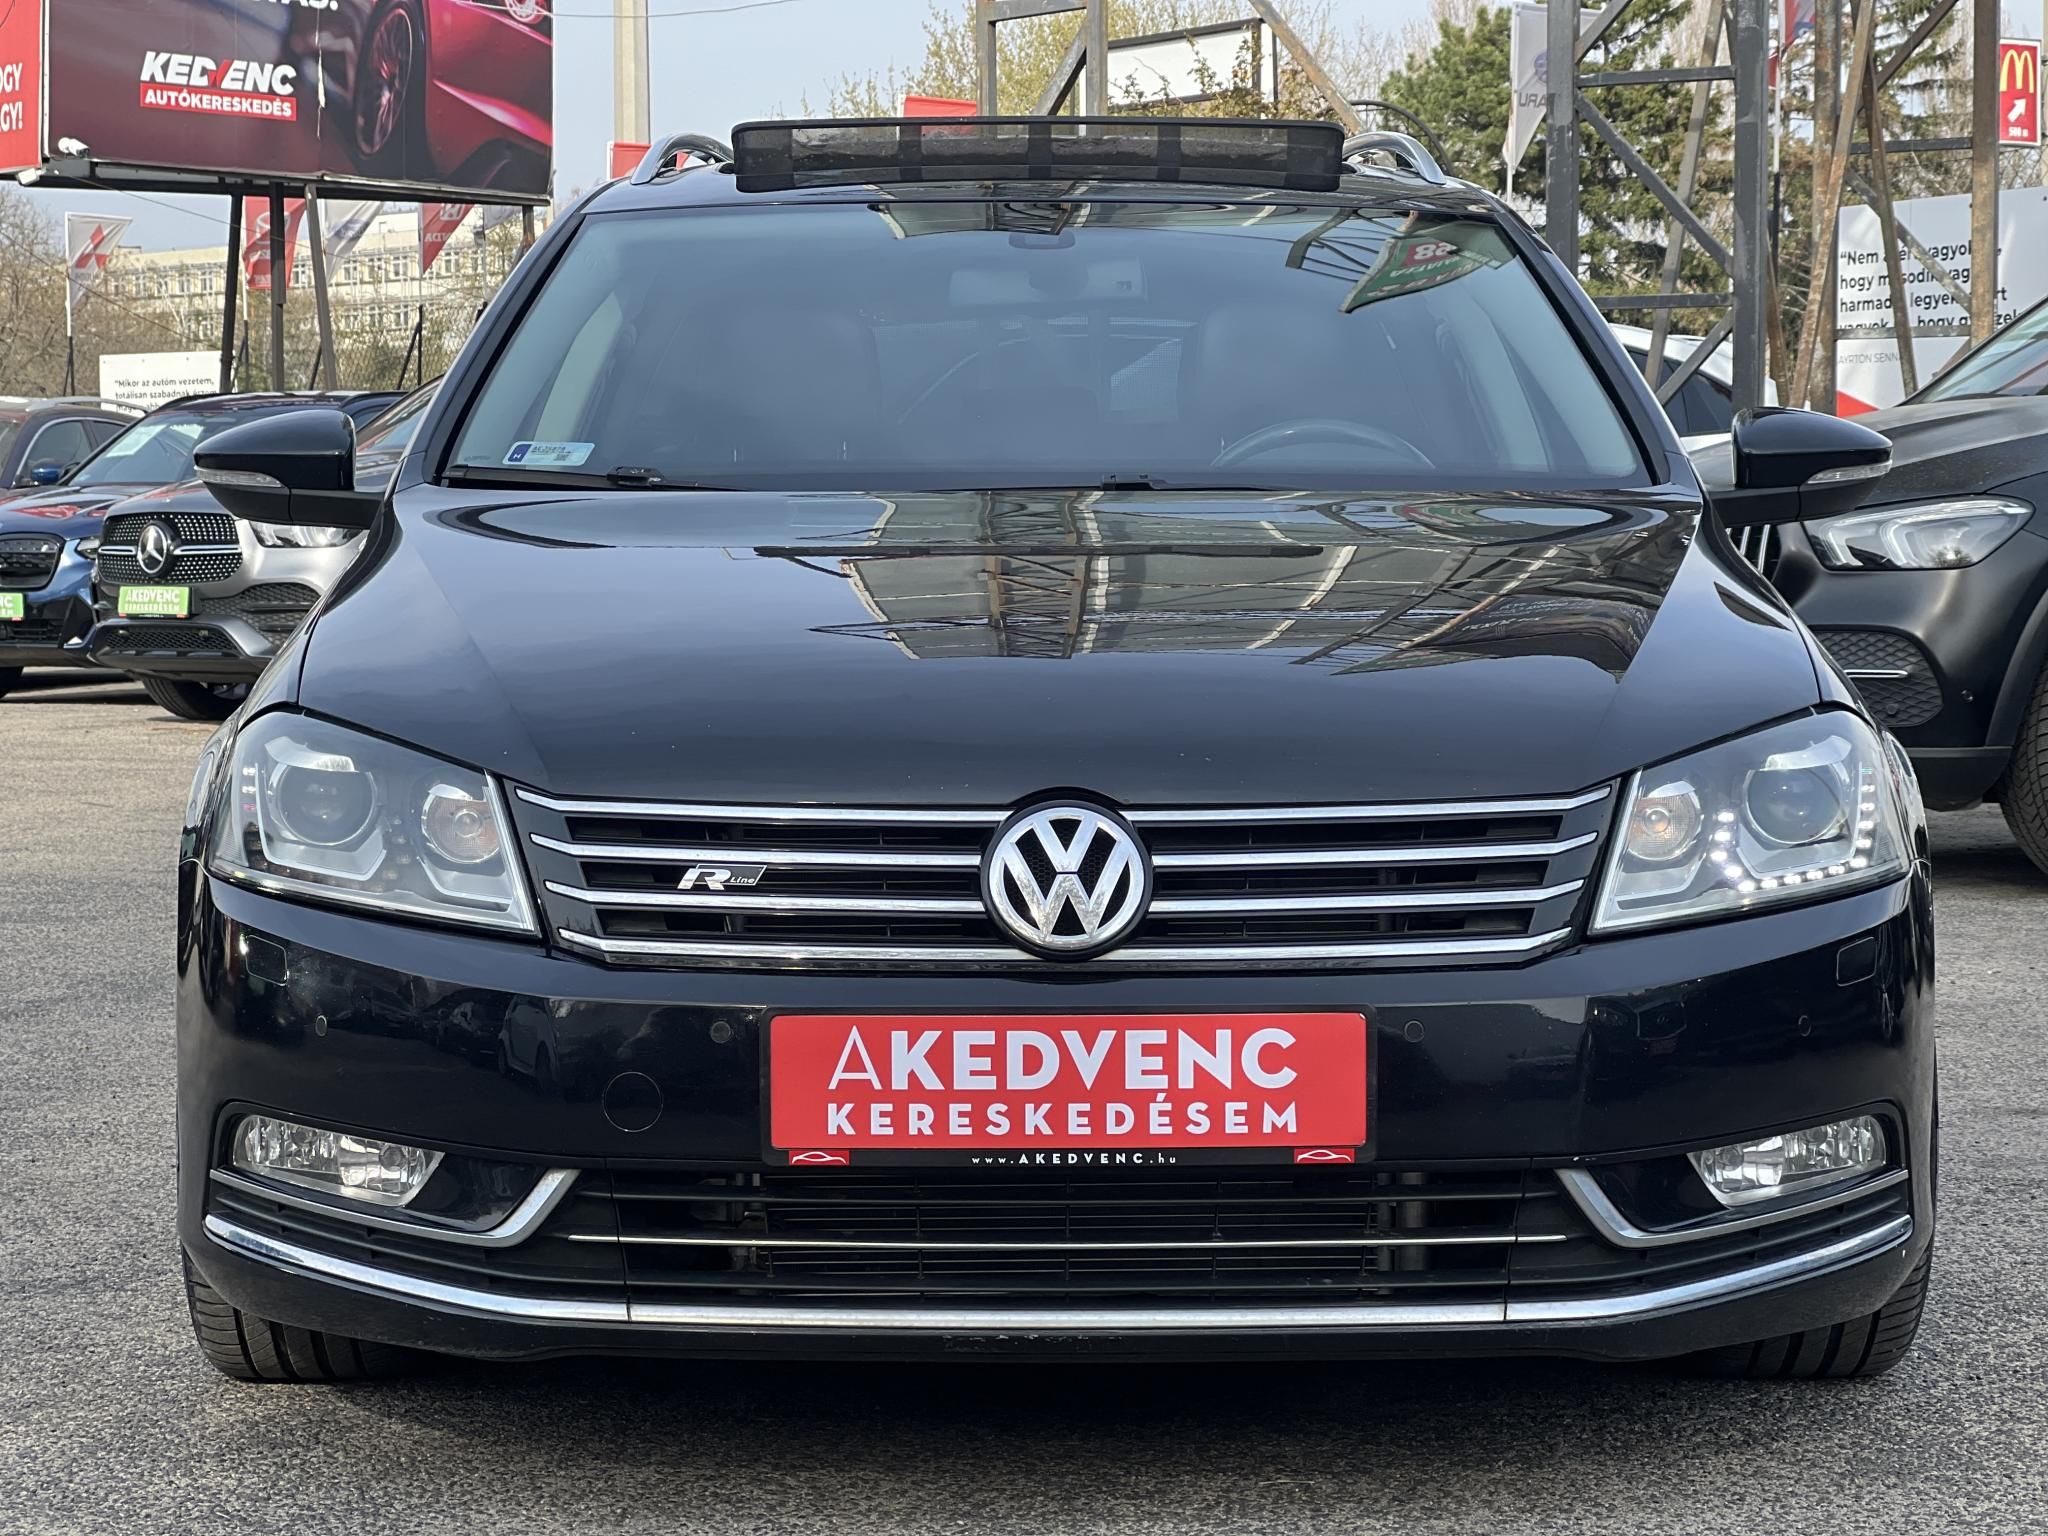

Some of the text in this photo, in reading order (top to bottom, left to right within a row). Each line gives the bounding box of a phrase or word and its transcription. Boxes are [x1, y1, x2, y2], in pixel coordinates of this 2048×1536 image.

[145, 89, 292, 117] AUTÓKERESKEDÉS
[1840, 274, 1874, 292] hogy
[1838, 351, 1899, 364] AYRTON SENN
[152, 378, 177, 387] autóm
[125, 589, 181, 602] AKEDVENC
[677, 868, 731, 890] R
[827, 1025, 1298, 1091] AKEDVENC
[827, 1093, 1298, 1135] KERESKEDÉSEM
[972, 1152, 1176, 1164] www.AKEDVENC.hu
